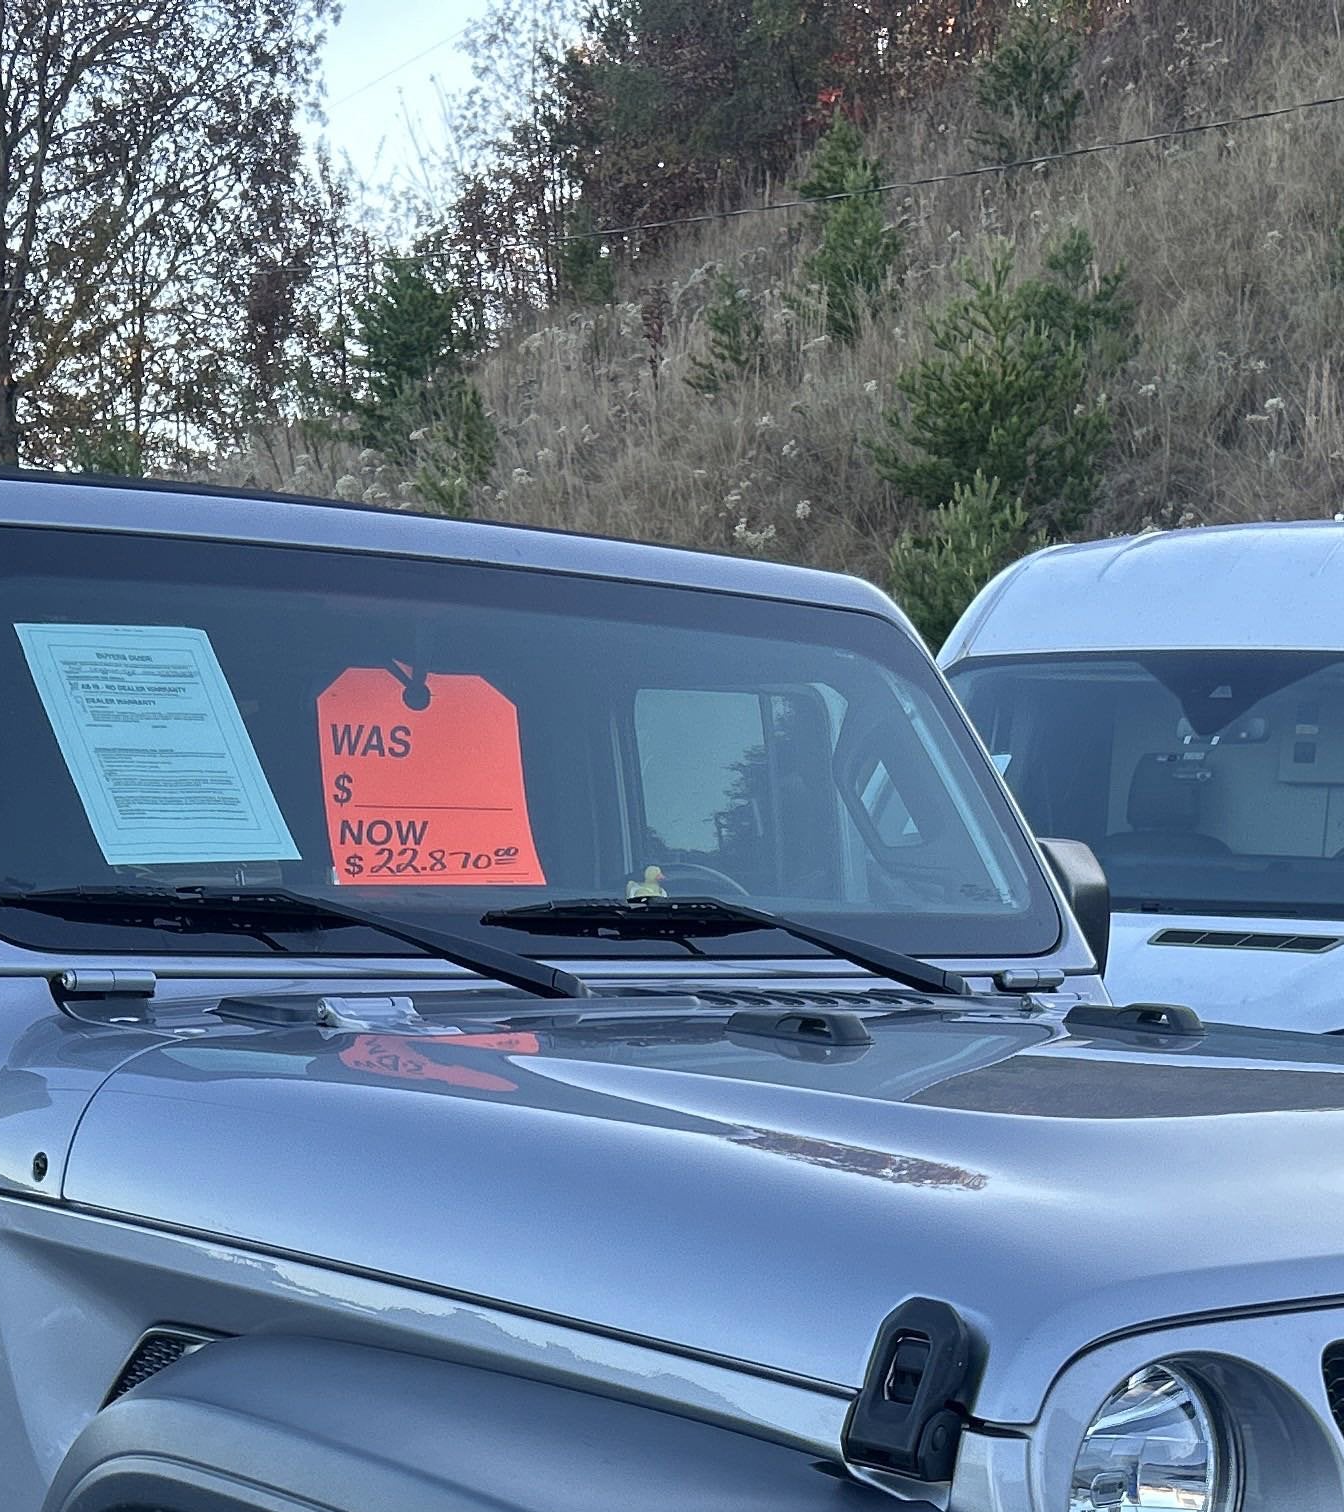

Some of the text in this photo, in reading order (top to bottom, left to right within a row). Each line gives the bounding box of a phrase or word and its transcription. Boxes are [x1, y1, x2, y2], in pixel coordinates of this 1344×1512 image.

[330, 723, 412, 758] WAS
[333, 771, 353, 807] $
[339, 819, 429, 846] NOW
[344, 853, 364, 878] $
